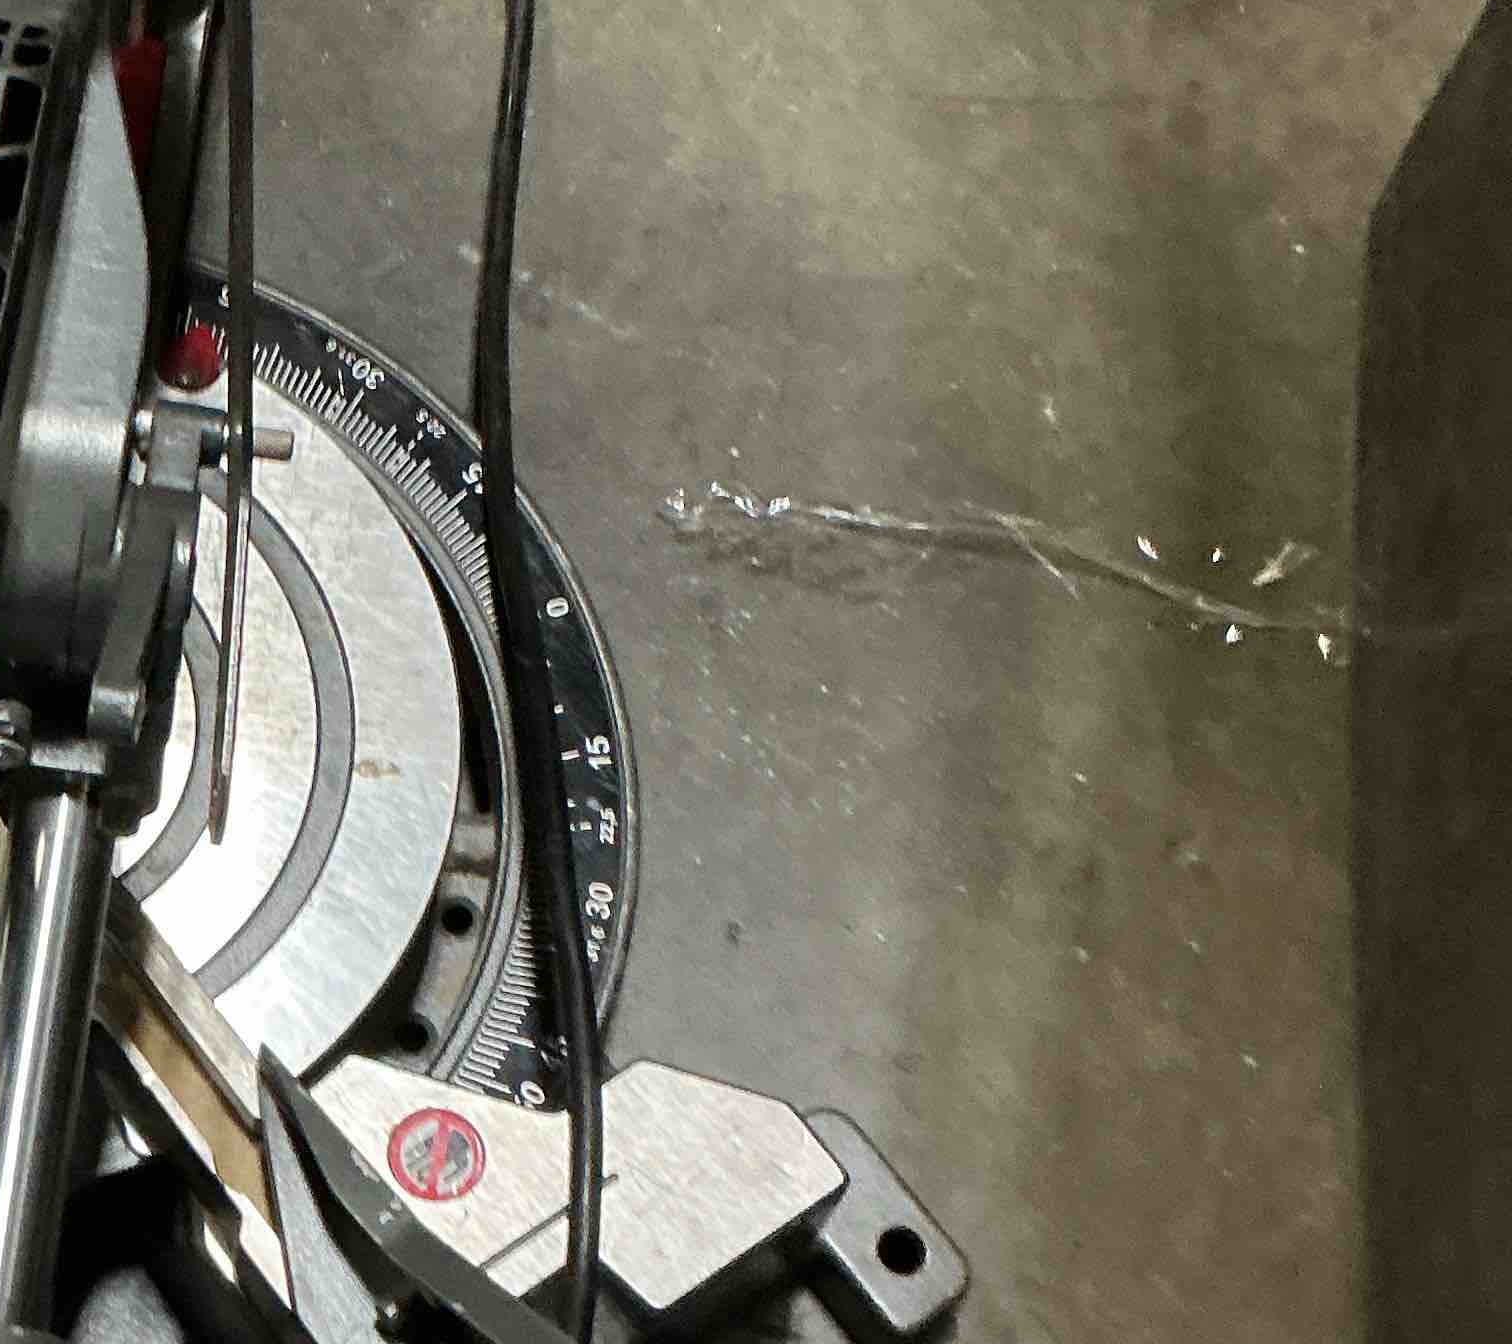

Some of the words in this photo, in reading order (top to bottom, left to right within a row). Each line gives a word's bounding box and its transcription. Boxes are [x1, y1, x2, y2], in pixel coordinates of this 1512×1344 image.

[351, 357, 385, 390] 30
[545, 596, 569, 618] 0
[585, 734, 613, 771] 15
[585, 881, 614, 921] 30
